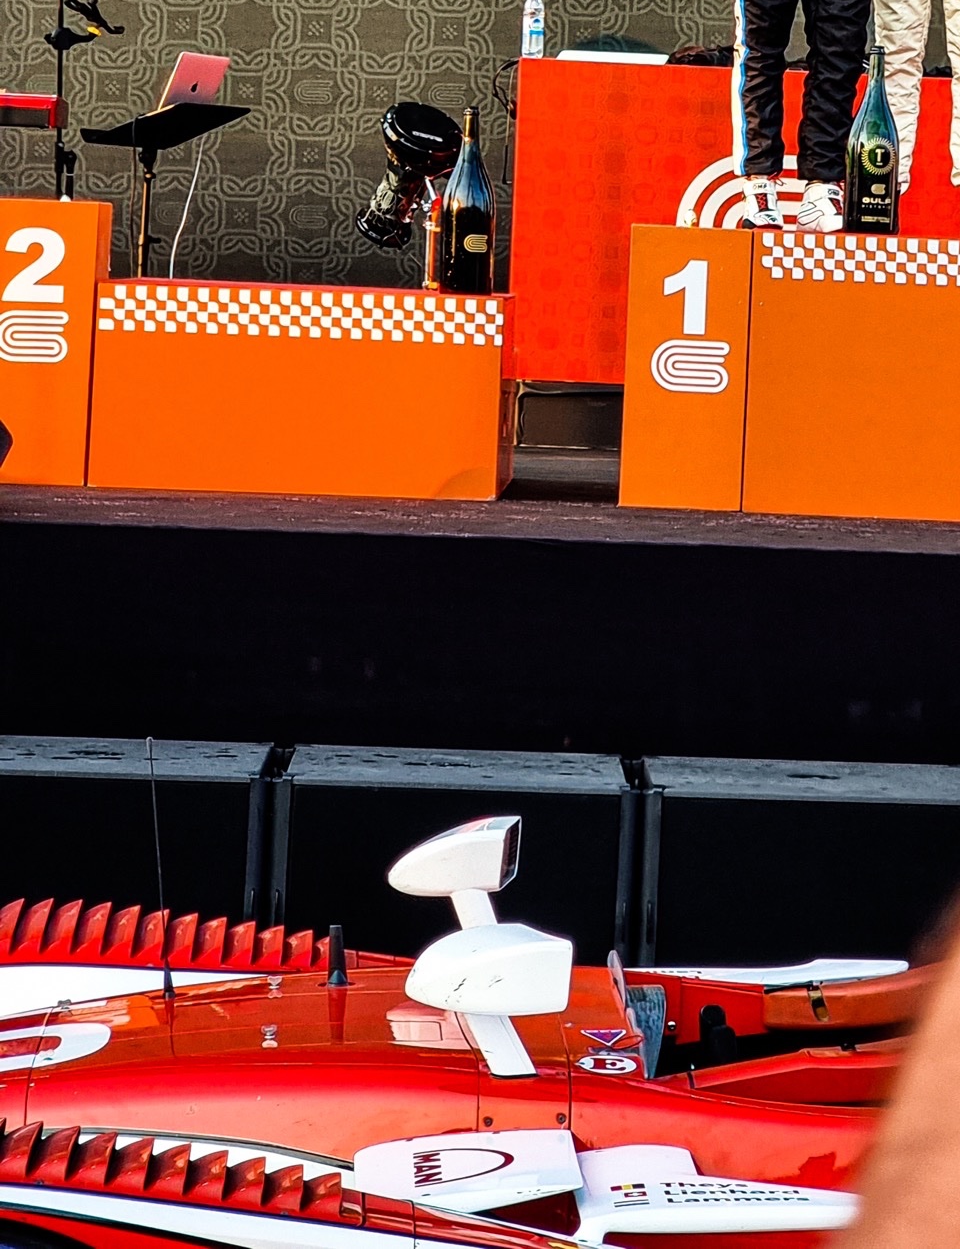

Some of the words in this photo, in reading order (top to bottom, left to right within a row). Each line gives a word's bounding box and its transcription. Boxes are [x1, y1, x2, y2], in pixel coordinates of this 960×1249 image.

[2, 227, 65, 303] 2
[663, 260, 708, 335] 1
[413, 1152, 443, 1187] MAN
